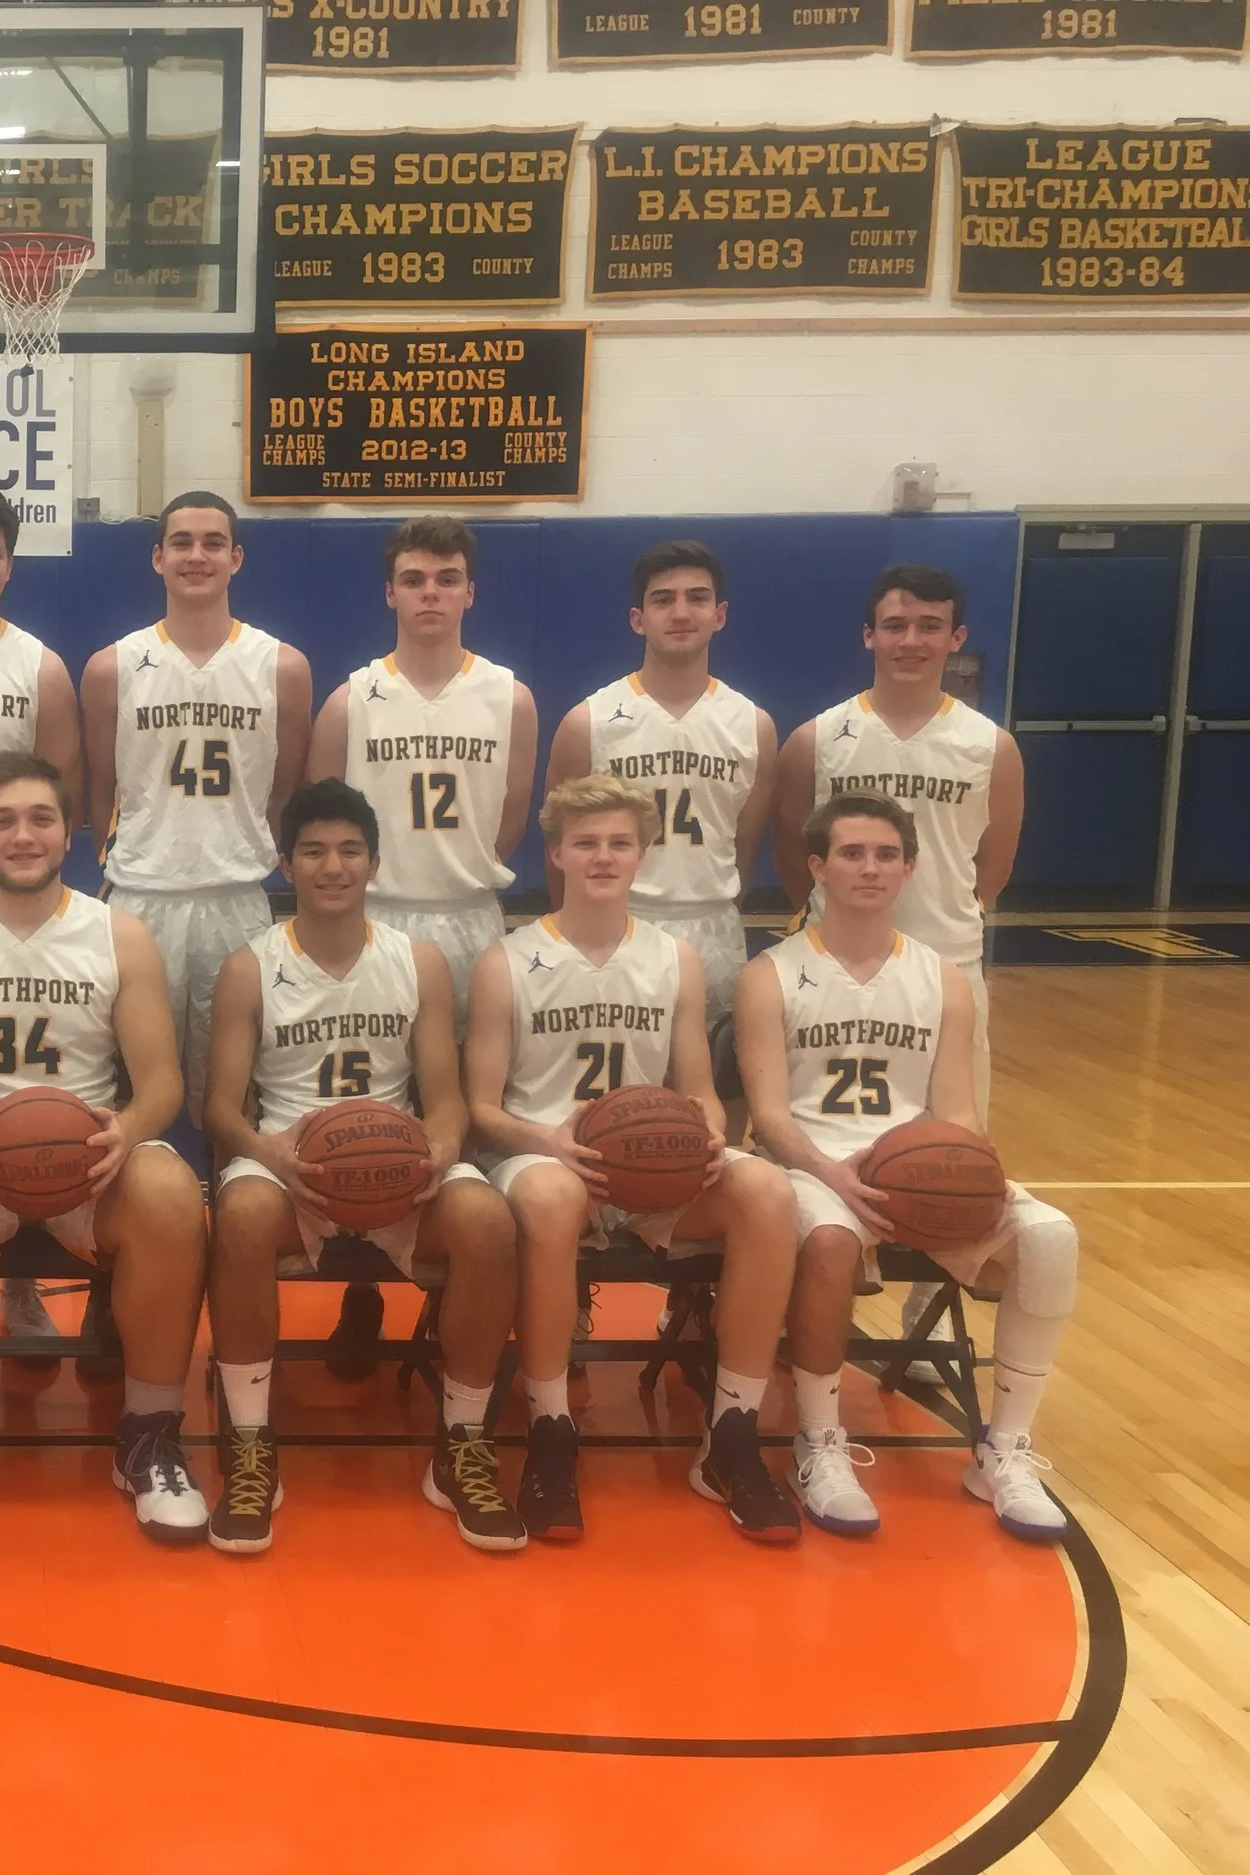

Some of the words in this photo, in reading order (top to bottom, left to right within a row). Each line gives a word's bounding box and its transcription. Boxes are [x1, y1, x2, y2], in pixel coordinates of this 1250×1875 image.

[585, 14, 649, 33] LEAGUE
[684, 4, 762, 38] 1981
[792, 7, 860, 26] COUNTY
[1041, 9, 1117, 39] 1981
[311, 26, 390, 59] 1981
[394, 150, 567, 185] SOCCER
[605, 146, 663, 177] L.I.
[674, 142, 928, 177] CHAMPIONS
[1026, 138, 1211, 171] LEAGUE
[638, 187, 890, 221] BASEBALL
[963, 177, 1250, 210] TRI-CHAMPION
[275, 201, 533, 235] CHAMPIONS
[611, 234, 673, 251] LEAGUE
[850, 230, 918, 246] COUNTY
[274, 260, 332, 277] LEAGUE
[362, 252, 446, 283] 1983
[473, 258, 534, 275] COUNTY
[717, 239, 804, 271] 1983
[848, 258, 915, 275] CHAMPS
[608, 262, 672, 280] CHAMPS
[1041, 256, 1184, 287] 1983-84
[311, 341, 390, 364] LONG
[407, 340, 525, 364] ISLAND
[327, 368, 506, 392] CHAMPIONS
[270, 397, 343, 428] BOYS
[369, 395, 562, 428] BASKETBALL
[264, 434, 325, 450] LEAGUE
[361, 439, 468, 461] 2012-13
[504, 431, 567, 448] COUNTY
[263, 450, 326, 466] CHAMPS
[503, 447, 567, 464] CHAMPS
[322, 471, 371, 488] STATE
[384, 470, 506, 488] SEMI-FINALIST
[136, 702, 262, 731] NORTHPORT
[366, 735, 497, 763] NORTHPORT
[170, 739, 231, 796] 45
[609, 750, 739, 783] NORTHPORT
[410, 773, 459, 829] 12
[653, 788, 704, 845] 14
[274, 1013, 409, 1048] NORTHPORT
[531, 1002, 665, 1035] NORTHPORT
[795, 1018, 932, 1052] NORTHPORT
[318, 1050, 371, 1097] 15
[574, 1042, 624, 1101] 21
[821, 1057, 891, 1115] 25
[324, 1124, 412, 1152] SPALDING
[621, 1136, 702, 1152] TF-1000
[330, 1165, 411, 1185] TF-1000
